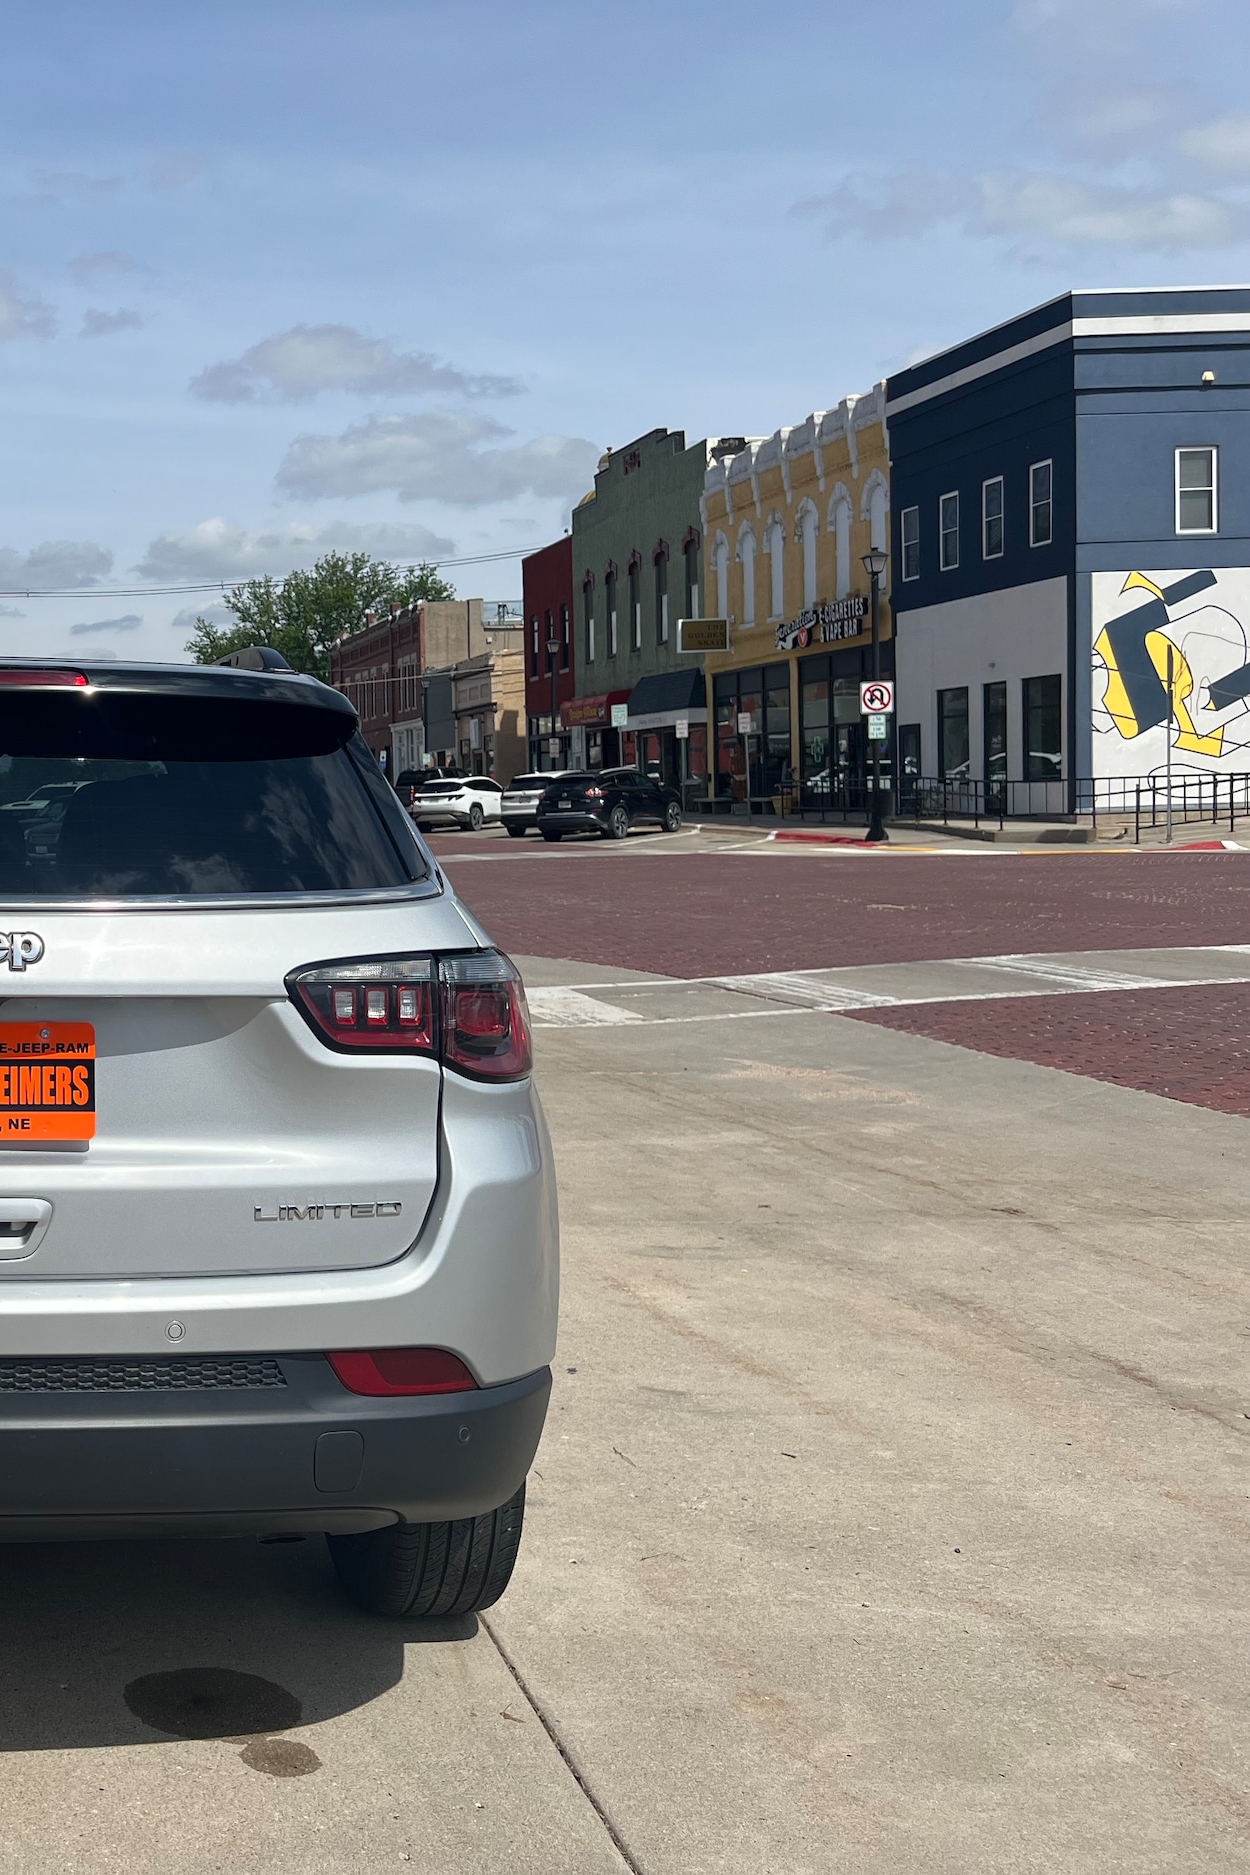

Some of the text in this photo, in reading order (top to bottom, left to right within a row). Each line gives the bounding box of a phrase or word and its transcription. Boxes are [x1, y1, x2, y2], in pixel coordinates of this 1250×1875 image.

[818, 597, 864, 625] E-CIGARETTES
[687, 631, 725, 639] GOLDEN
[825, 621, 842, 643] VAPE
[843, 618, 858, 639] BAR
[8, 1118, 31, 1130] NE
[254, 1201, 403, 1222] LIMITED
